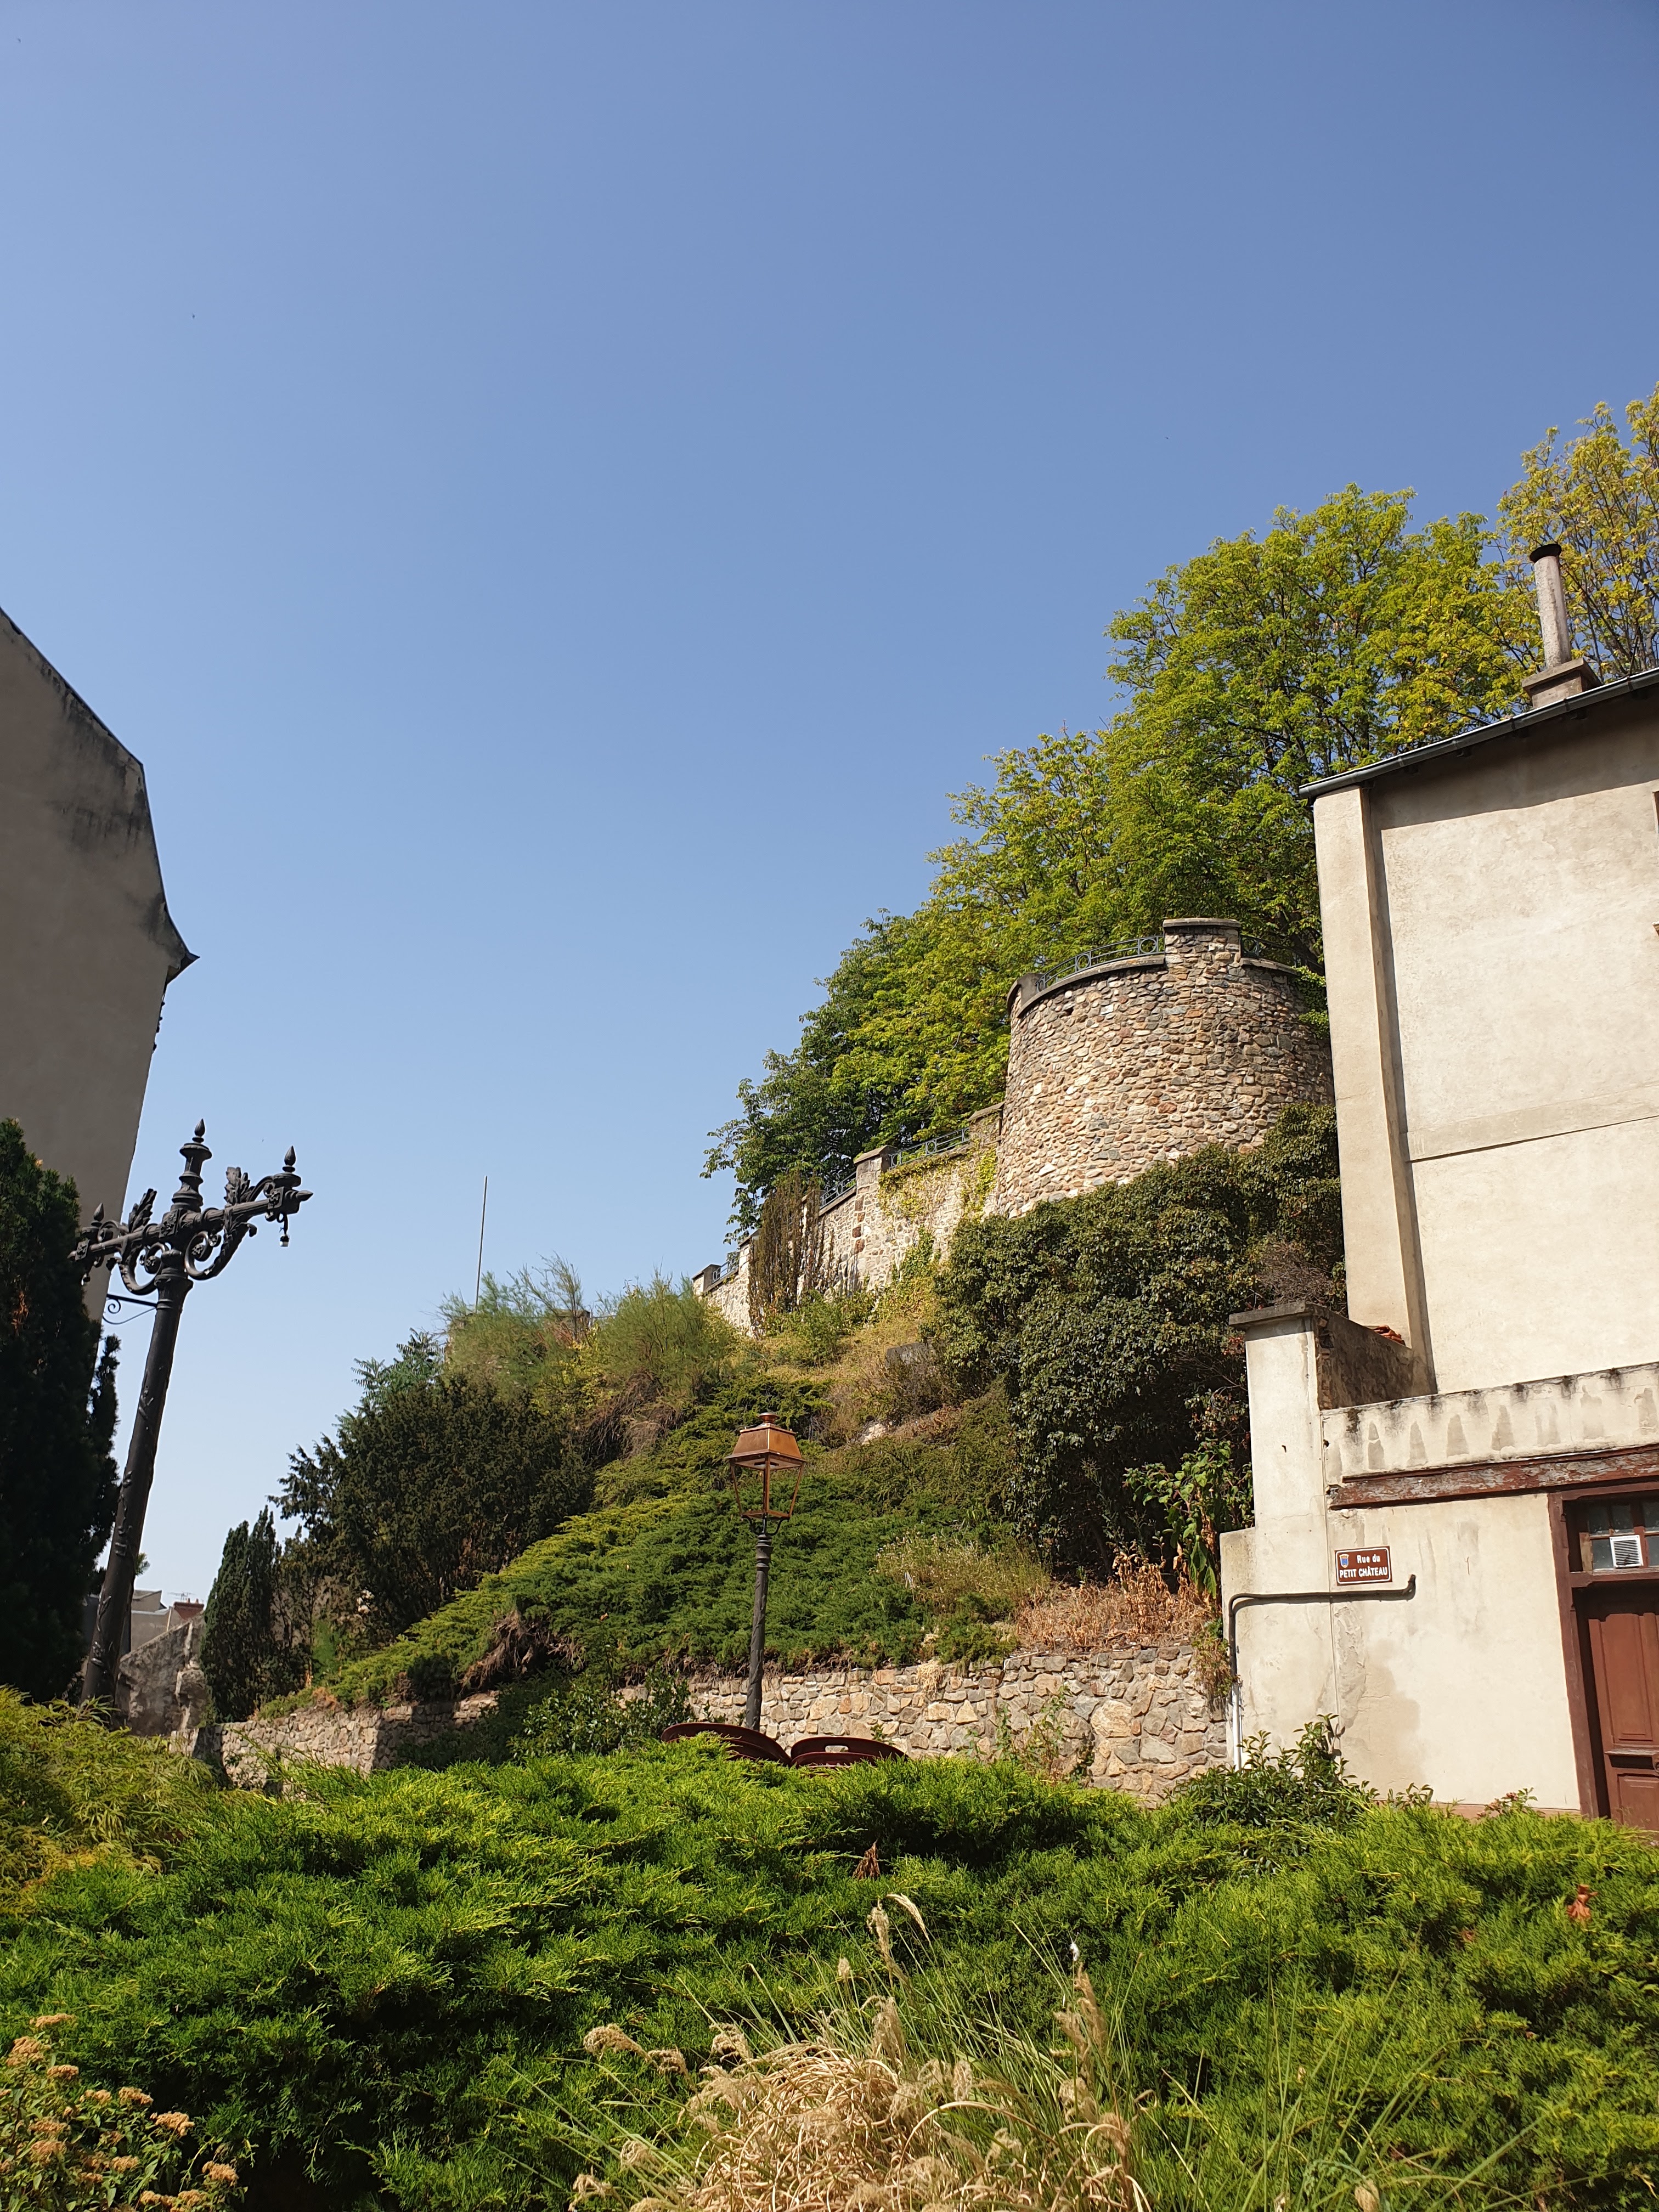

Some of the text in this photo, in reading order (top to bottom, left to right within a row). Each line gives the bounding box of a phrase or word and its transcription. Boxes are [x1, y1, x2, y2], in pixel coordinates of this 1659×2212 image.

[1357, 1554, 1380, 1564] Rue du
[1339, 1566, 1387, 1578] PETIT CHÂTEAU
